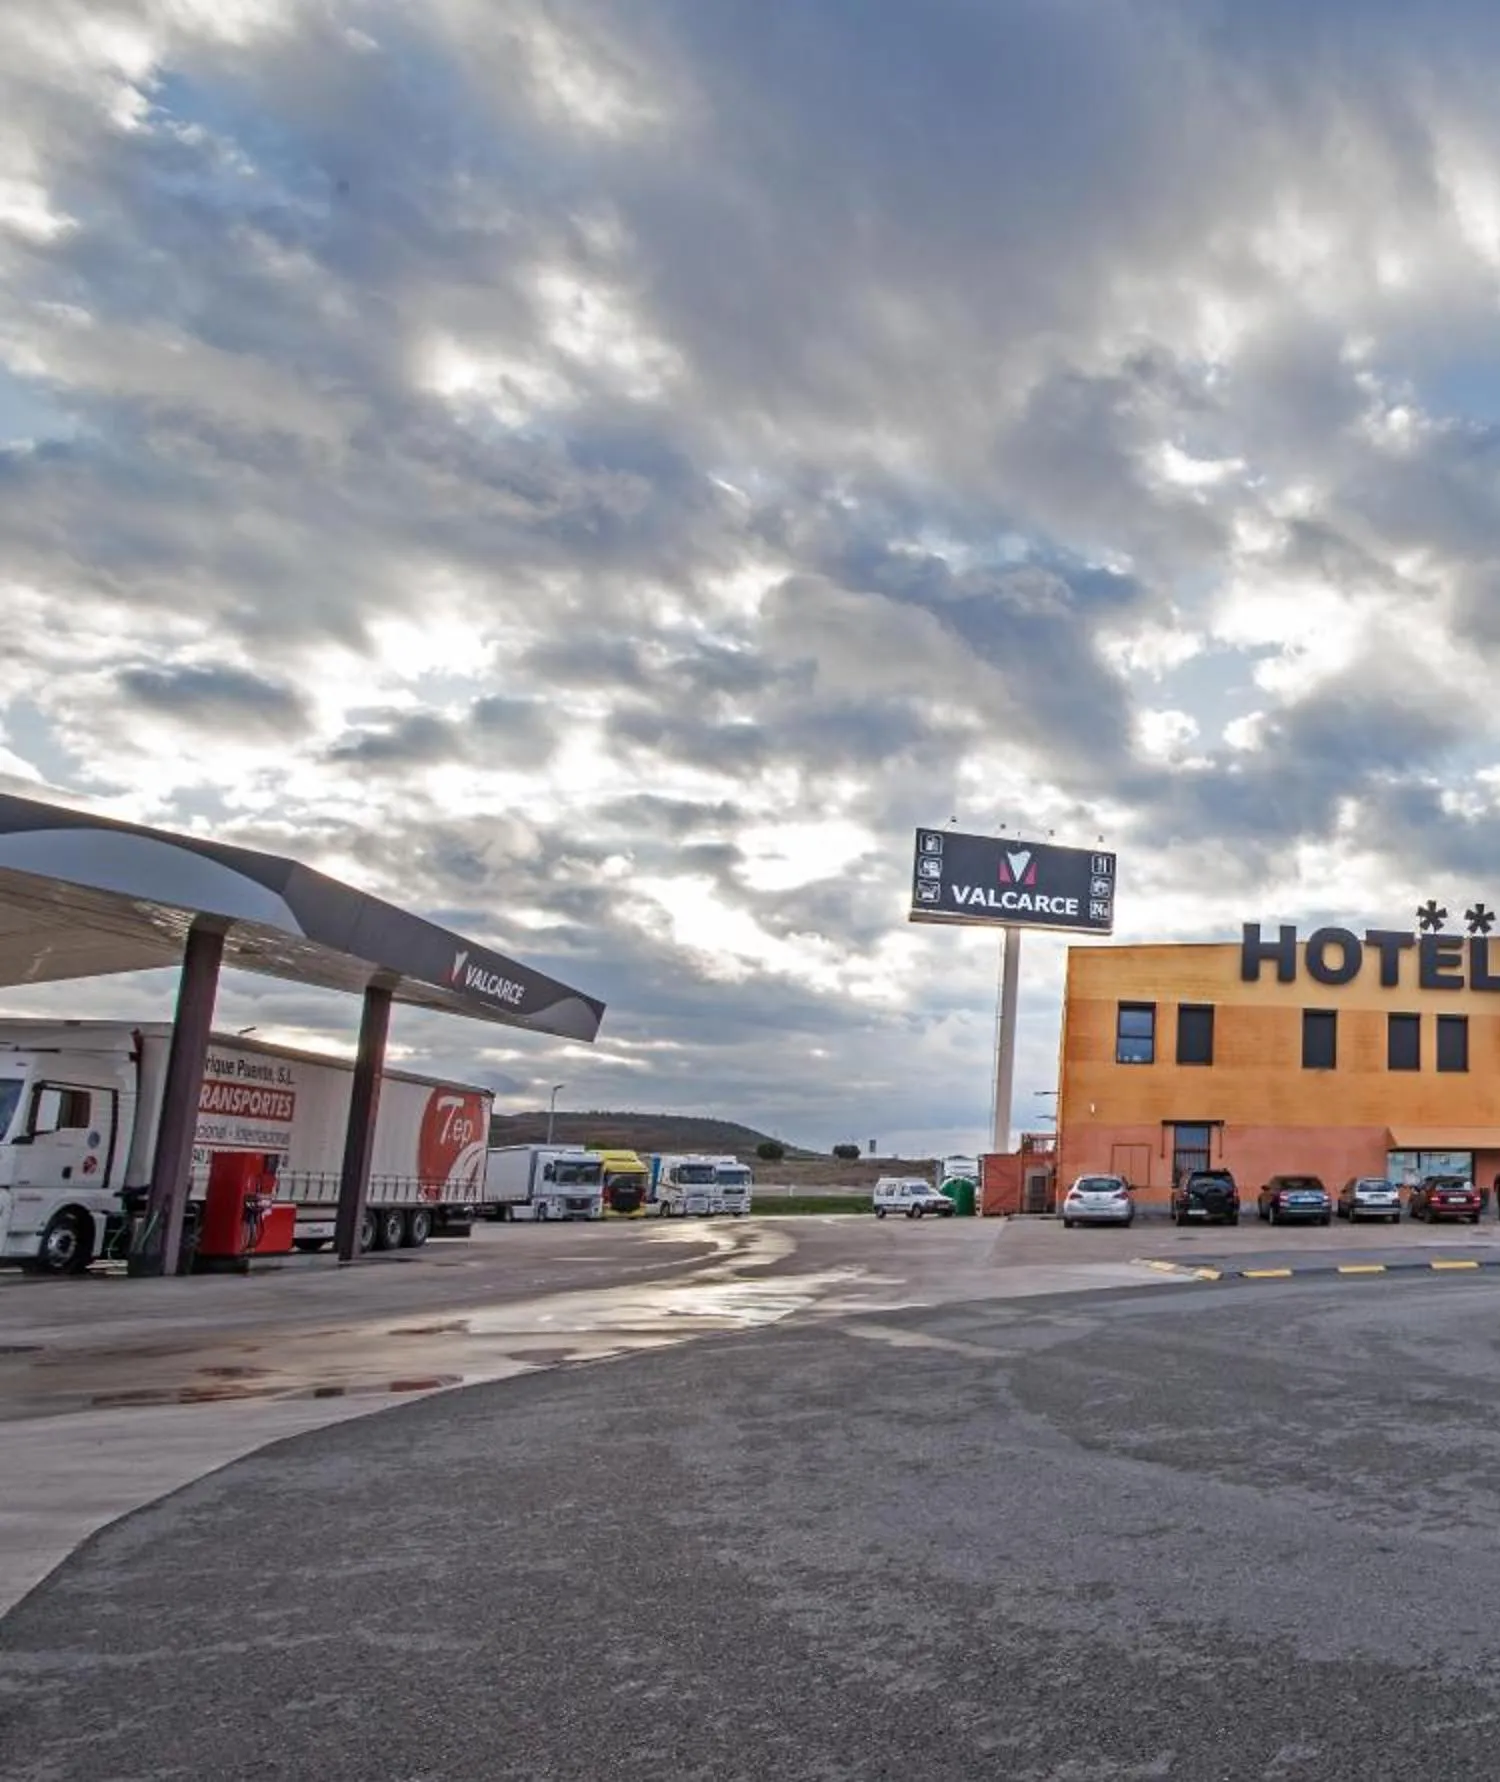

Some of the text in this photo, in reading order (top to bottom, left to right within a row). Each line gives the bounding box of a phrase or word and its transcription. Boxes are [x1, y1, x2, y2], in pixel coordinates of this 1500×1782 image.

[951, 884, 1079, 916] VALCARCE
[465, 964, 525, 1005] VALCARCE
[205, 1056, 235, 1078] rique
[198, 1083, 293, 1118] RANSPORTES
